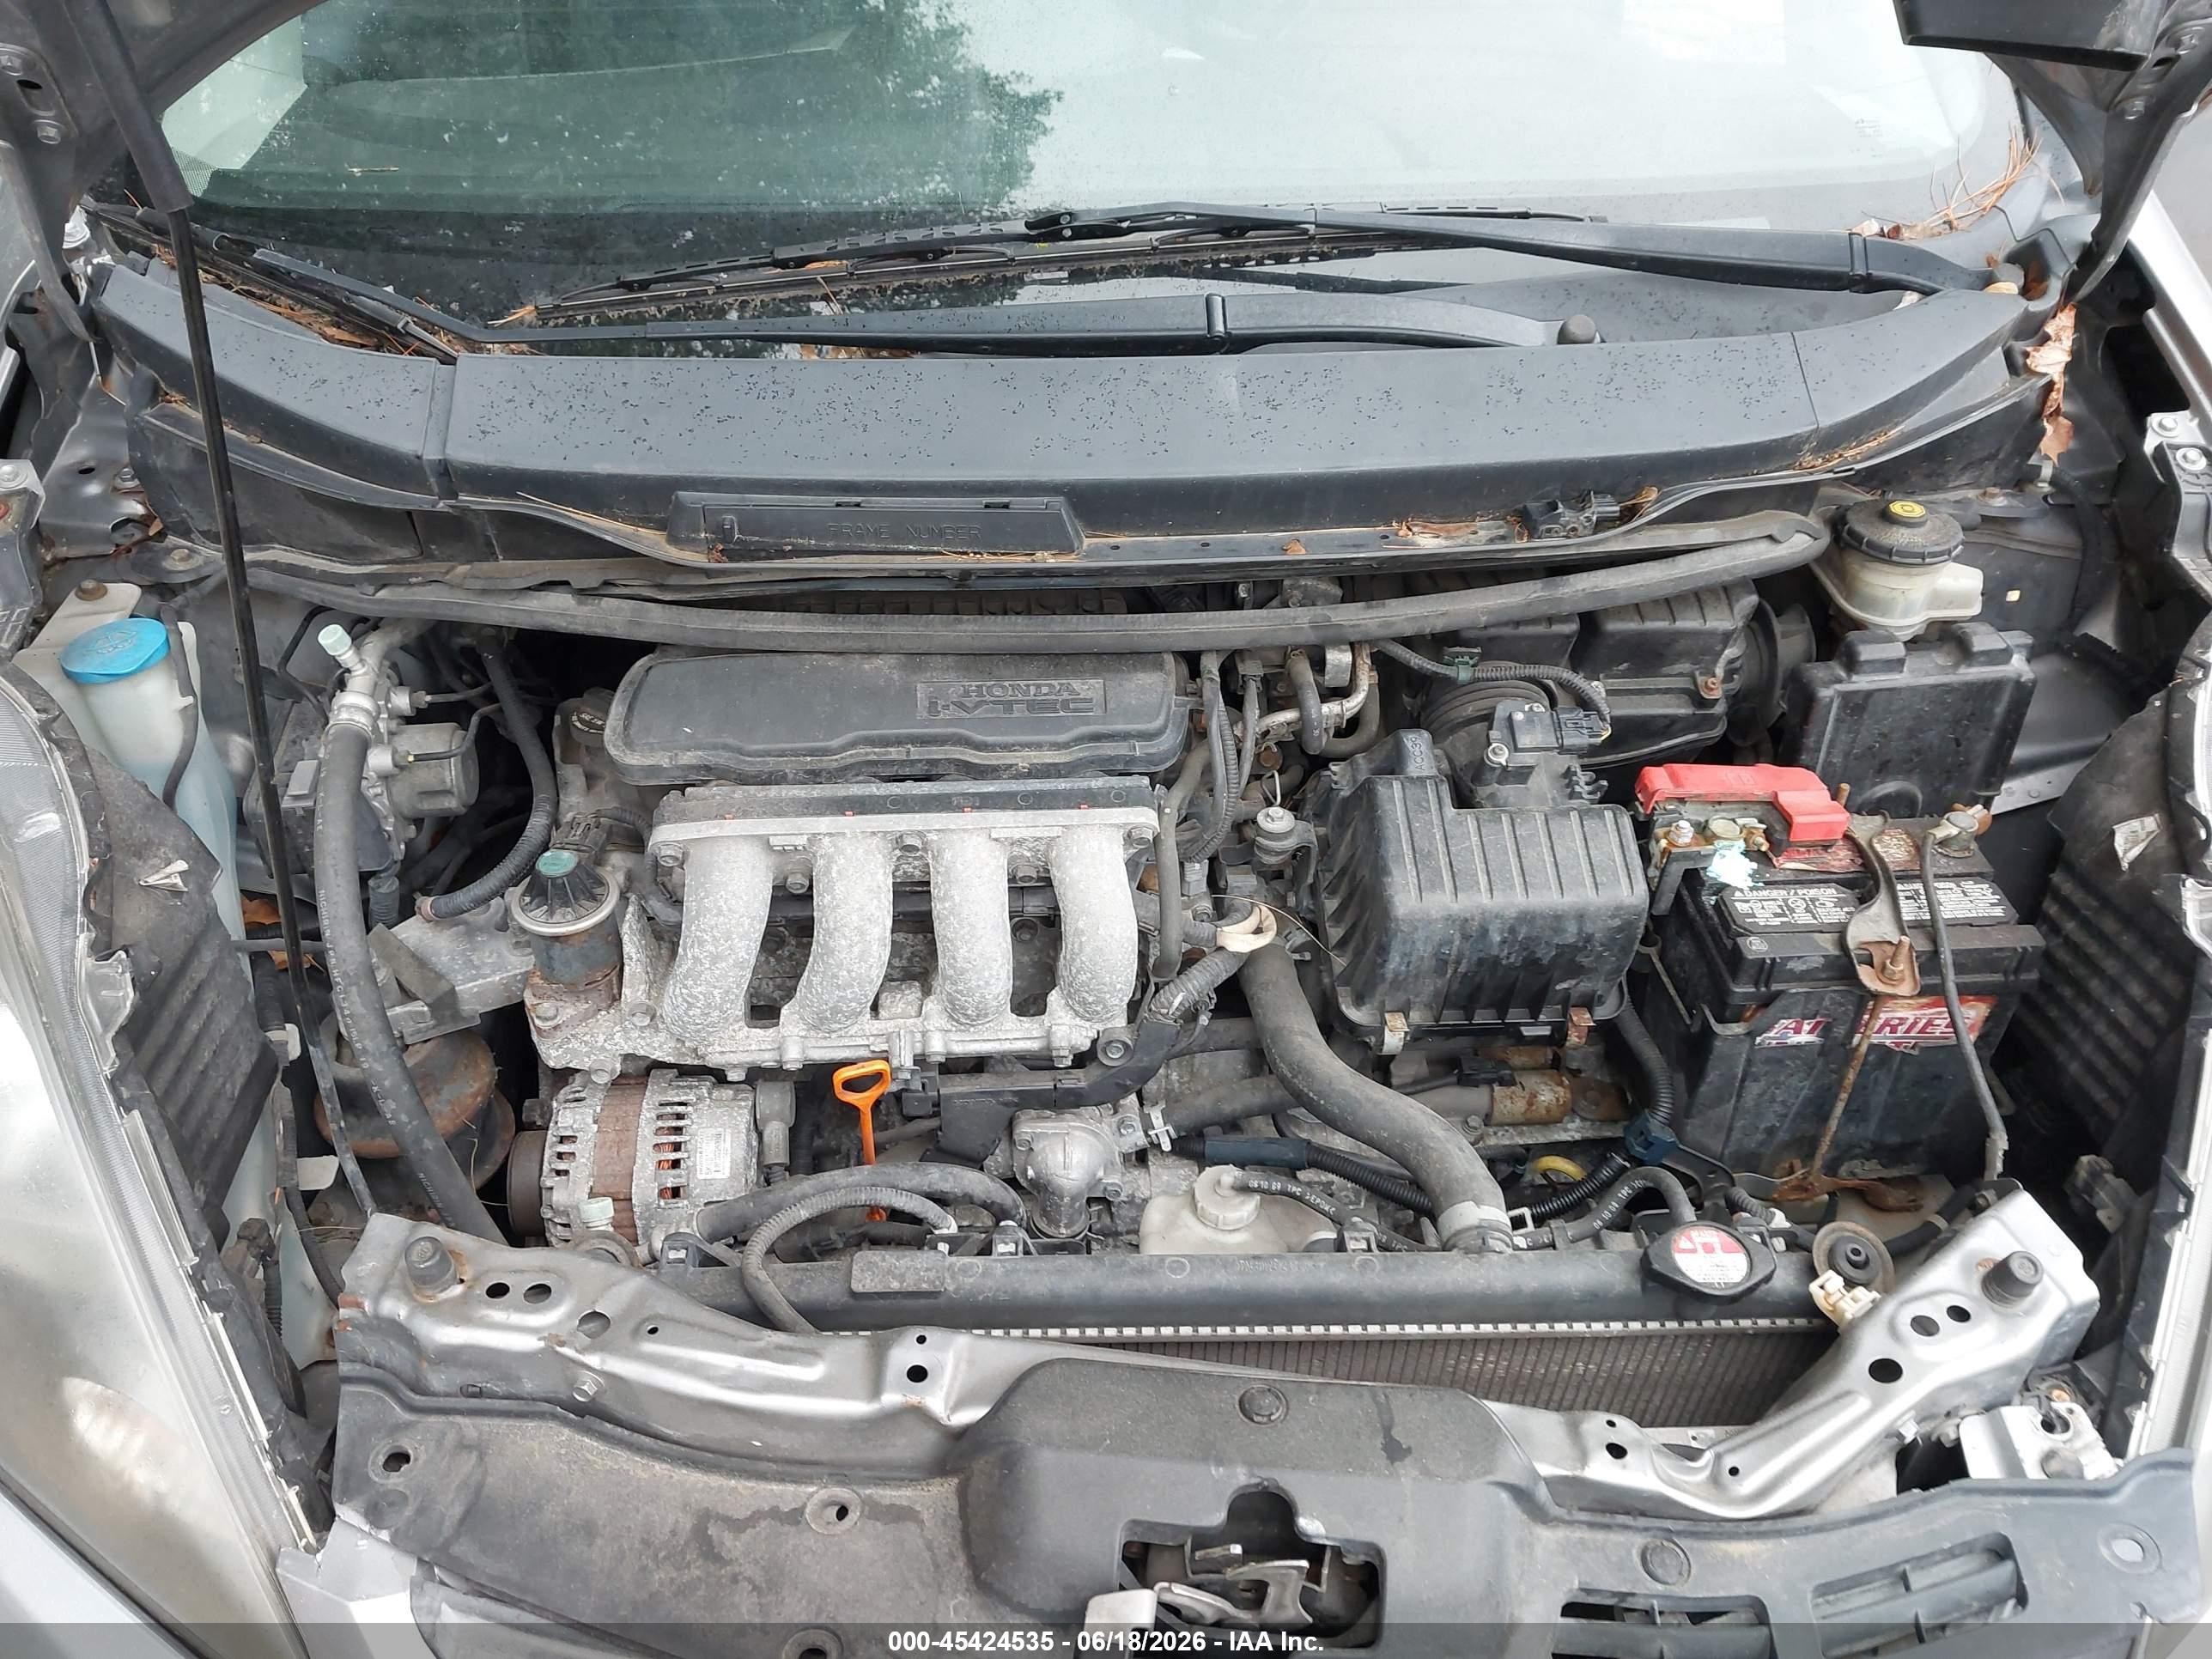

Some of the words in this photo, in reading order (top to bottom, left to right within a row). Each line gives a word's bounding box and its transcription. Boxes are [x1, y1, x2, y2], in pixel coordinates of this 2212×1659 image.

[826, 522, 890, 538] FRAME
[906, 524, 983, 540] NUMBER
[960, 682, 1080, 699] HONDA
[1742, 888, 1788, 897] DANGER
[1796, 887, 1837, 896] POISON
[1286, 1184, 1303, 1196] TPC
